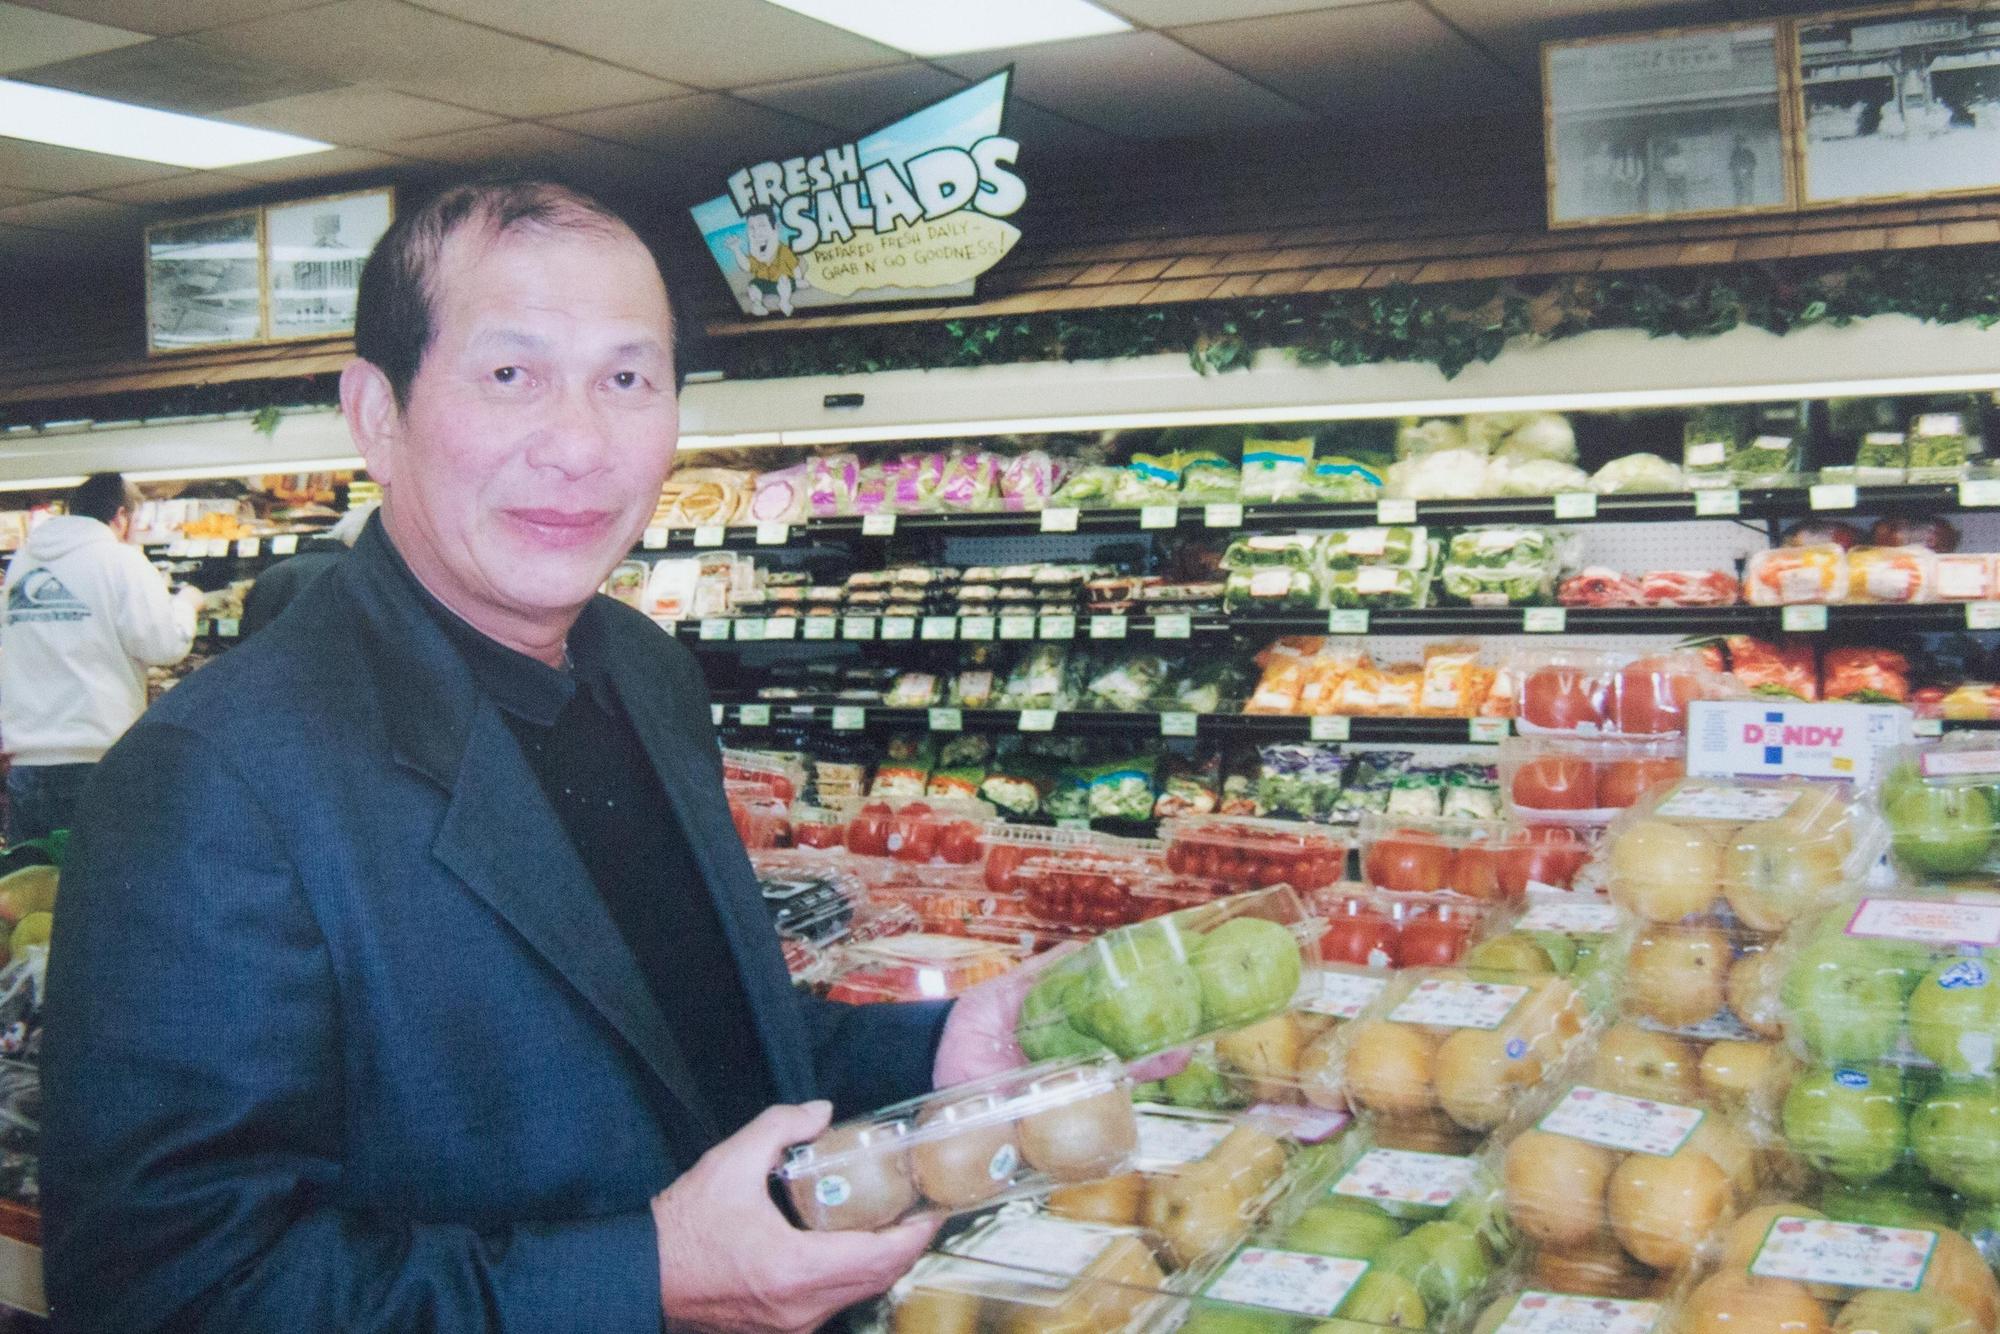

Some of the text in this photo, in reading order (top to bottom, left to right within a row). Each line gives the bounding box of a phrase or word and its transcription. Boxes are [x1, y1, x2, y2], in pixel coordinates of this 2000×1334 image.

[727, 143, 860, 215] FRESH
[781, 134, 1028, 255] SALADS
[814, 242, 874, 263] PREPARED
[880, 231, 921, 249] FRESH
[927, 222, 968, 241] DAILY
[822, 262, 859, 280] GRAB
[883, 254, 906, 268] GO
[914, 229, 1006, 265] GOODNESS!
[1743, 724, 1844, 747] DNDY
